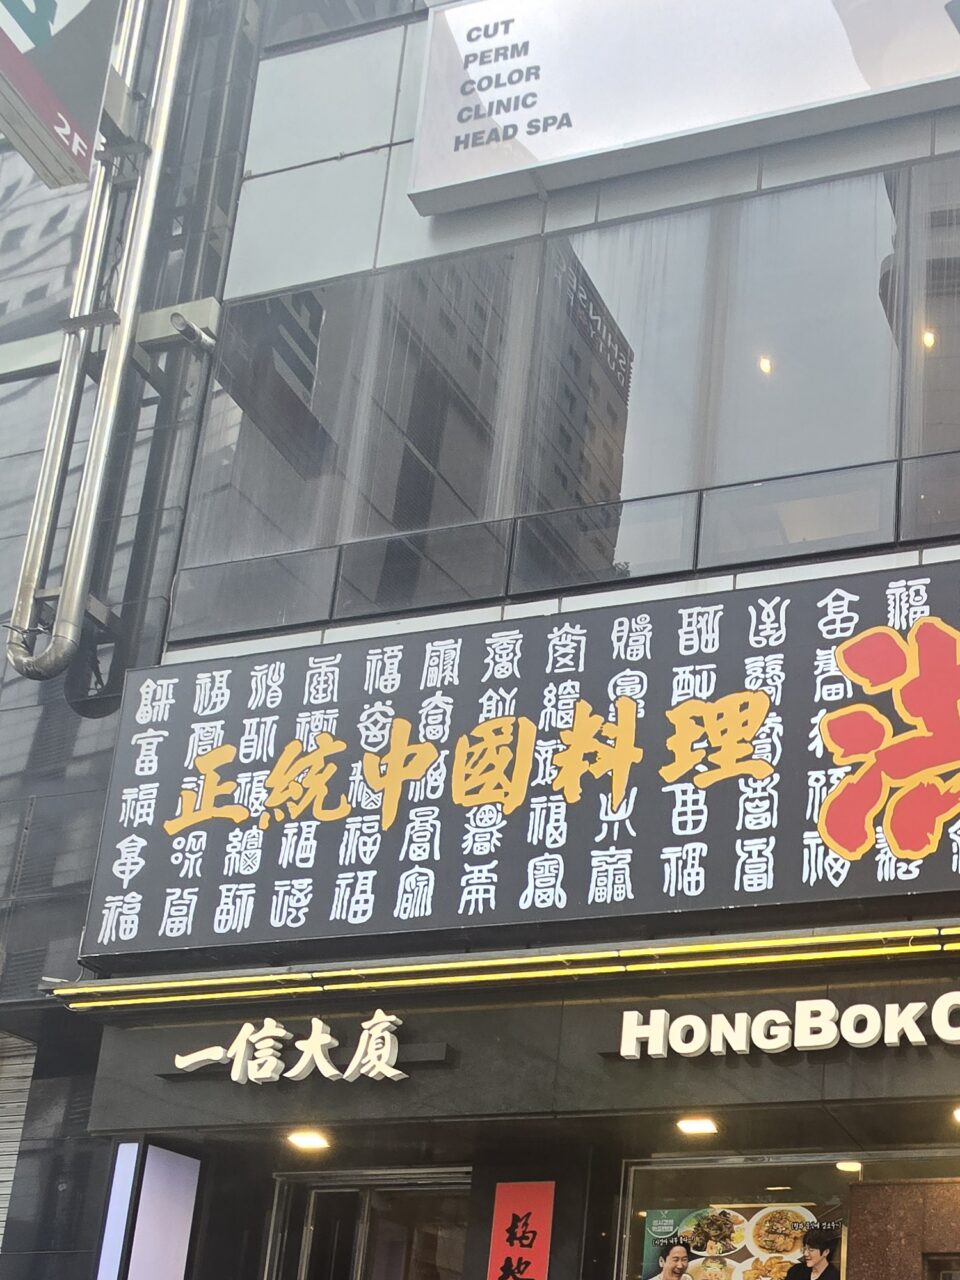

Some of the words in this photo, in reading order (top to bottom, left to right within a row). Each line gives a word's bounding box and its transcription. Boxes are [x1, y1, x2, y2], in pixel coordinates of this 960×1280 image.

[466, 19, 515, 43] CUT
[463, 41, 530, 70] PERM
[460, 65, 541, 96] COLOR
[457, 92, 538, 123] CLINIC
[54, 111, 88, 157] 2F
[453, 124, 518, 152] HEAD
[526, 112, 573, 137] SPA
[163, 690, 776, 837] 正統中國料理
[174, 1008, 410, 1085] 一信大廈
